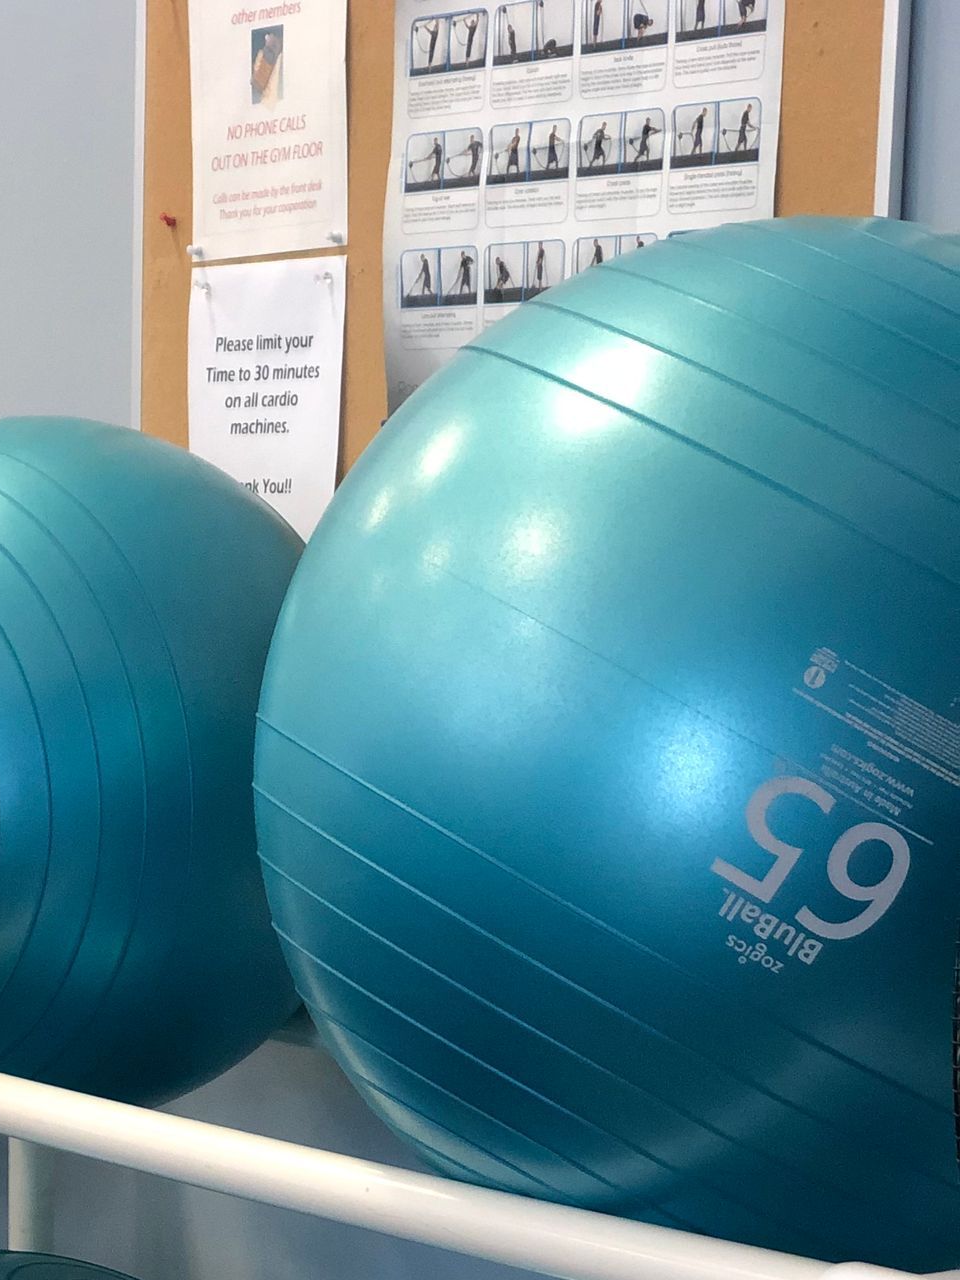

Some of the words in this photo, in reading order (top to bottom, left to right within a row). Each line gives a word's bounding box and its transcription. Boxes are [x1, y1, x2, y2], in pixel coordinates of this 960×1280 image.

[231, 8, 257, 25] other
[258, 2, 302, 21] members
[227, 124, 243, 141] NO
[244, 118, 277, 138] PHONE
[279, 114, 307, 133] CALLS
[211, 154, 231, 172] OUT
[232, 152, 249, 169] ON
[251, 148, 269, 167] THE
[270, 145, 291, 164] GYM
[292, 140, 323, 160] FLOOR
[215, 336, 253, 353] Please
[256, 333, 282, 350] limit
[285, 335, 314, 354] your
[206, 366, 236, 383] Time
[238, 366, 251, 382] to
[253, 364, 270, 381] 30
[272, 363, 320, 380] minutes
[225, 395, 241, 409] on
[243, 391, 259, 408] all
[261, 390, 299, 408] cardio
[230, 418, 290, 435] machines.
[263, 478, 292, 494] You!!
[710, 775, 911, 940] 65
[726, 935, 784, 973] zogics
